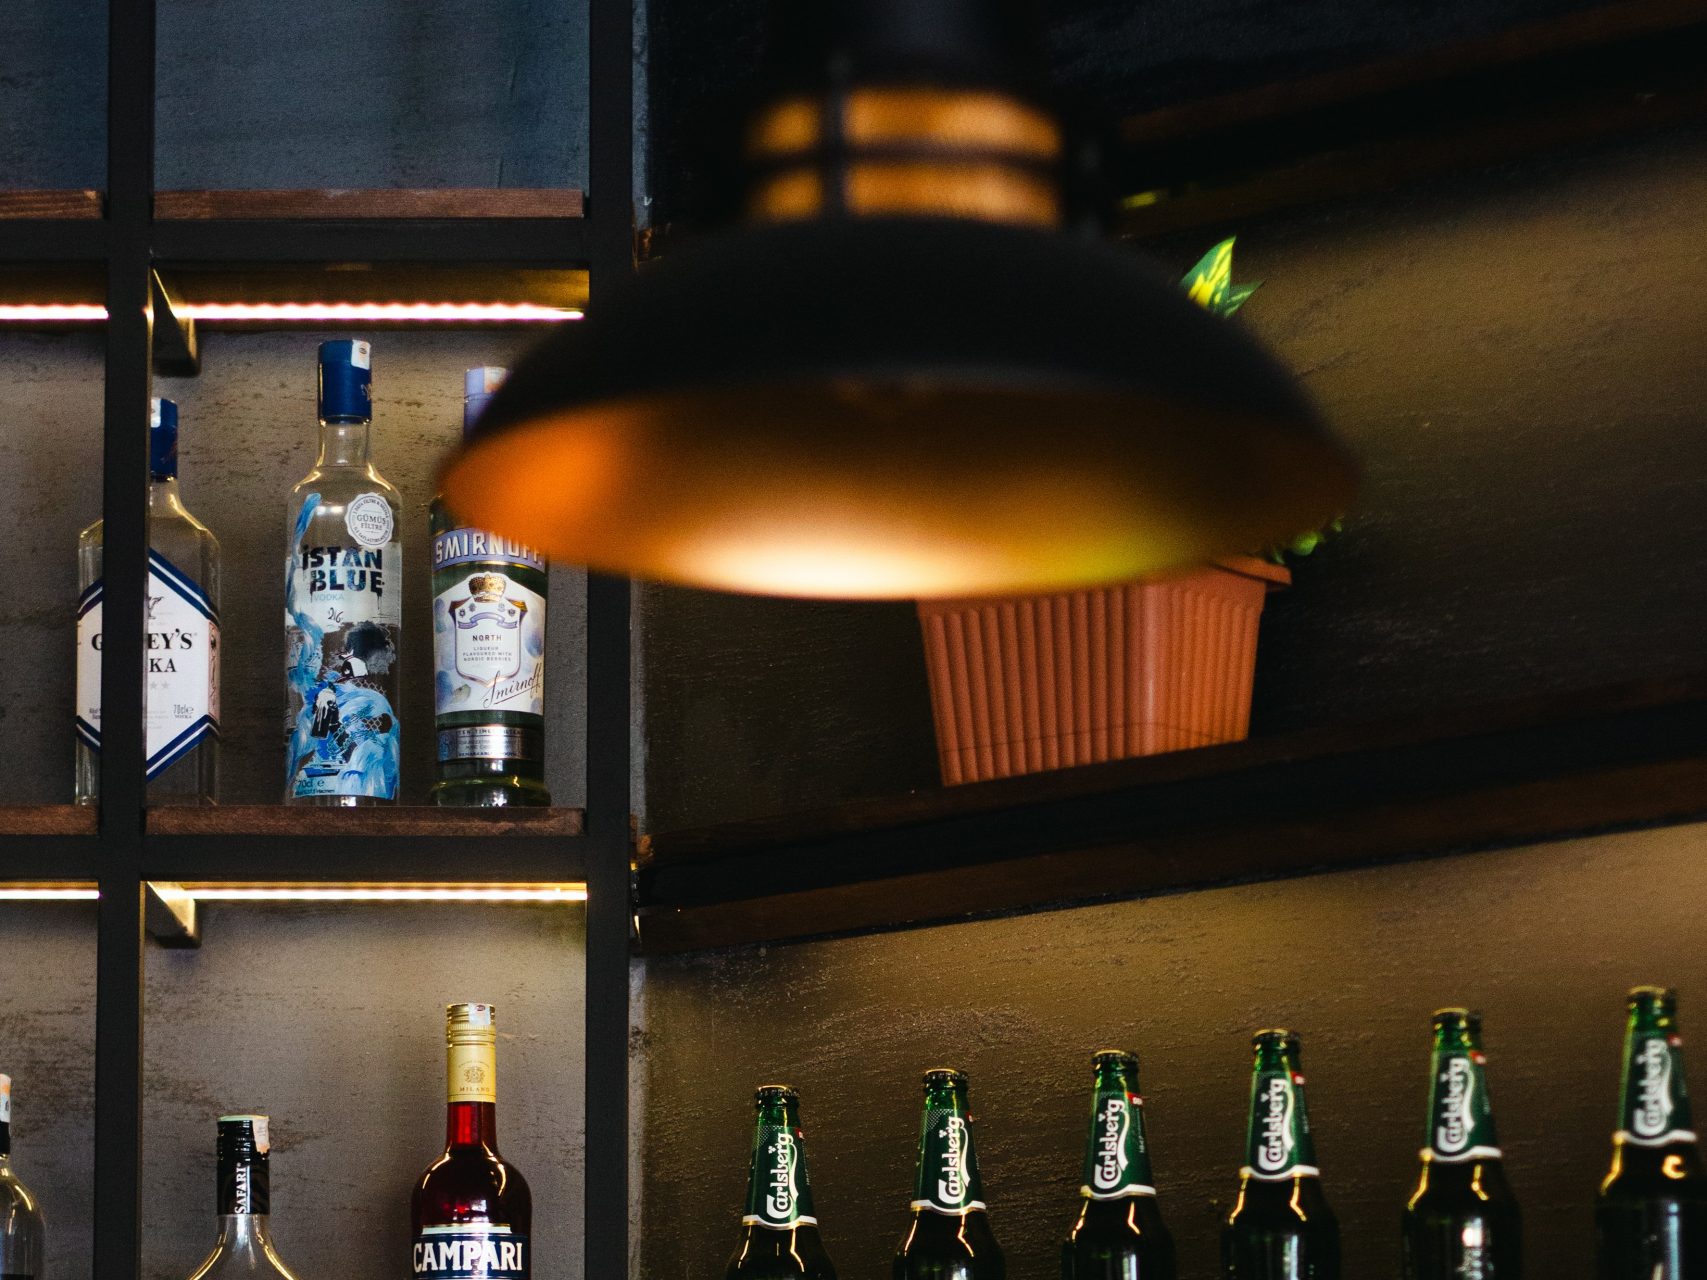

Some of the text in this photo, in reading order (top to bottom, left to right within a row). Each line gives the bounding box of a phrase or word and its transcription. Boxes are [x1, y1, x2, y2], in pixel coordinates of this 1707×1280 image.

[310, 569, 384, 598] BLUE
[1094, 1098, 1129, 1190] Carlsberg
[1258, 1078, 1294, 1171] Carlsberg
[1437, 1057, 1474, 1153] Carlsberg
[234, 1167, 247, 1214] SAFARI
[766, 1132, 797, 1219] Carlsberg
[938, 1116, 968, 1205] Carlsberg
[413, 1240, 523, 1273] CAMPARI
